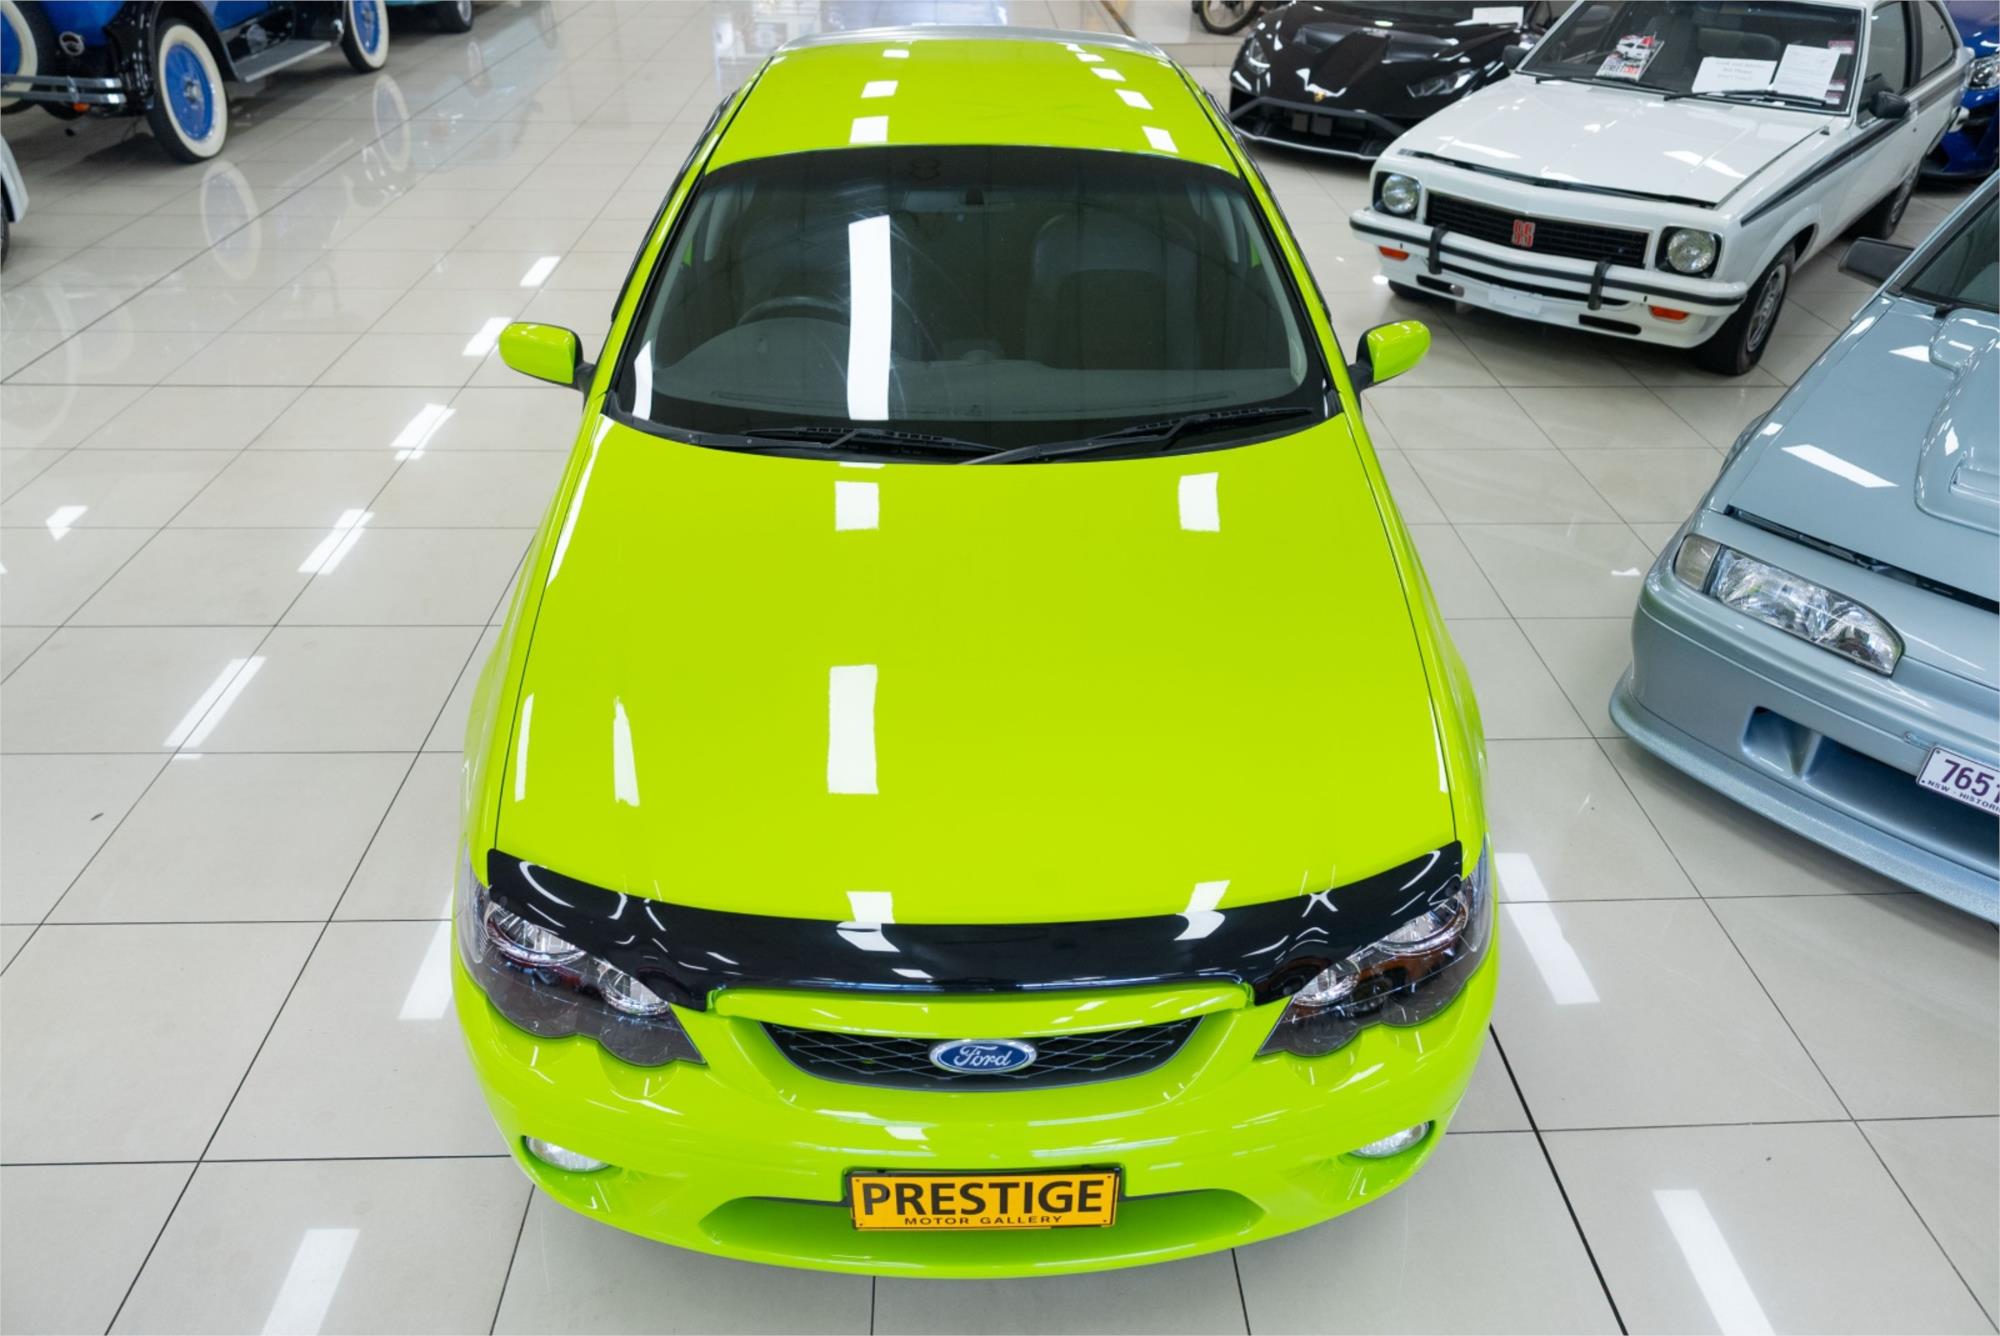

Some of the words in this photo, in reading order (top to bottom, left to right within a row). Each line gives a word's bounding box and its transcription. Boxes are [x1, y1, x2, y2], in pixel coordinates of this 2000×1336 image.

[1927, 780, 1950, 792] NSW
[1959, 792, 2000, 812] HISTORI
[954, 1045, 1013, 1067] Ford
[862, 1180, 1105, 1216] PRESTIGE
[904, 1217, 970, 1226] MOTOR
[979, 1215, 1062, 1225] GALLERY
